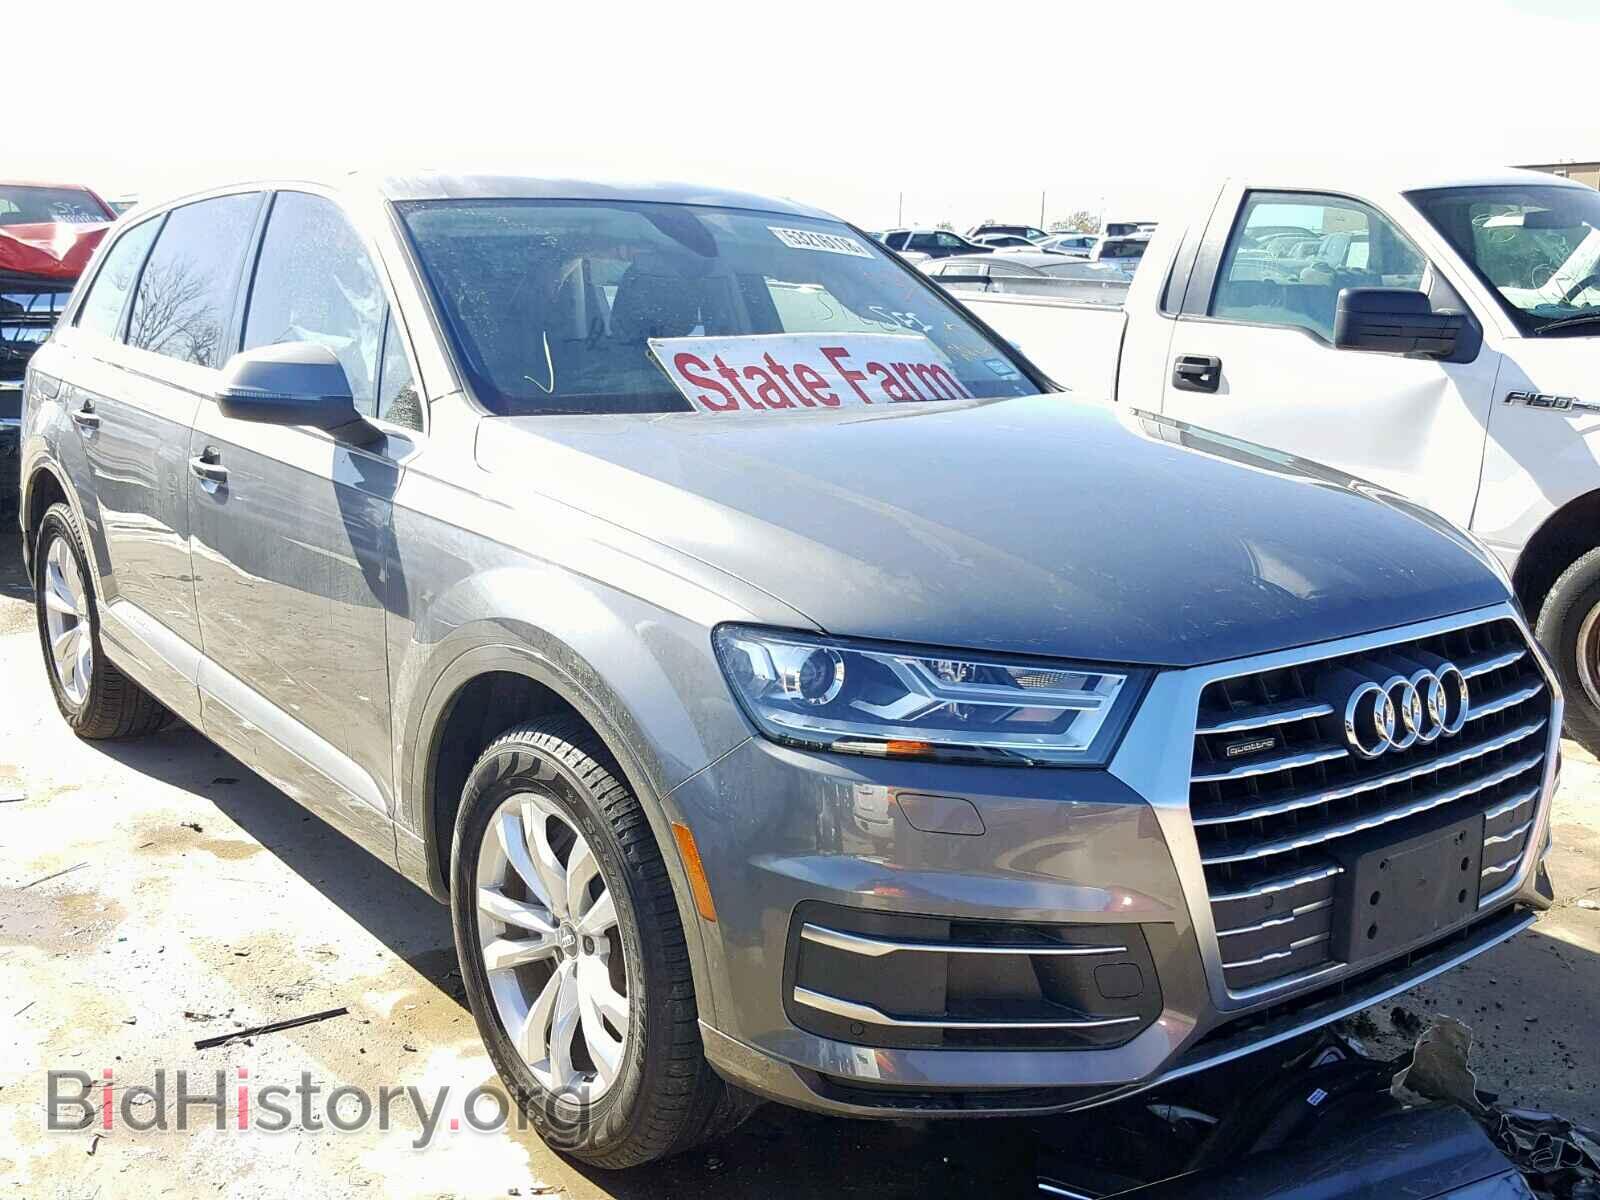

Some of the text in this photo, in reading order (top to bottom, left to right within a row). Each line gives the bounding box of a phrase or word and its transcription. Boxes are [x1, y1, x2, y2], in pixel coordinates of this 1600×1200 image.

[673, 346, 976, 412] State Farm
[1229, 739, 1274, 756] quattro
